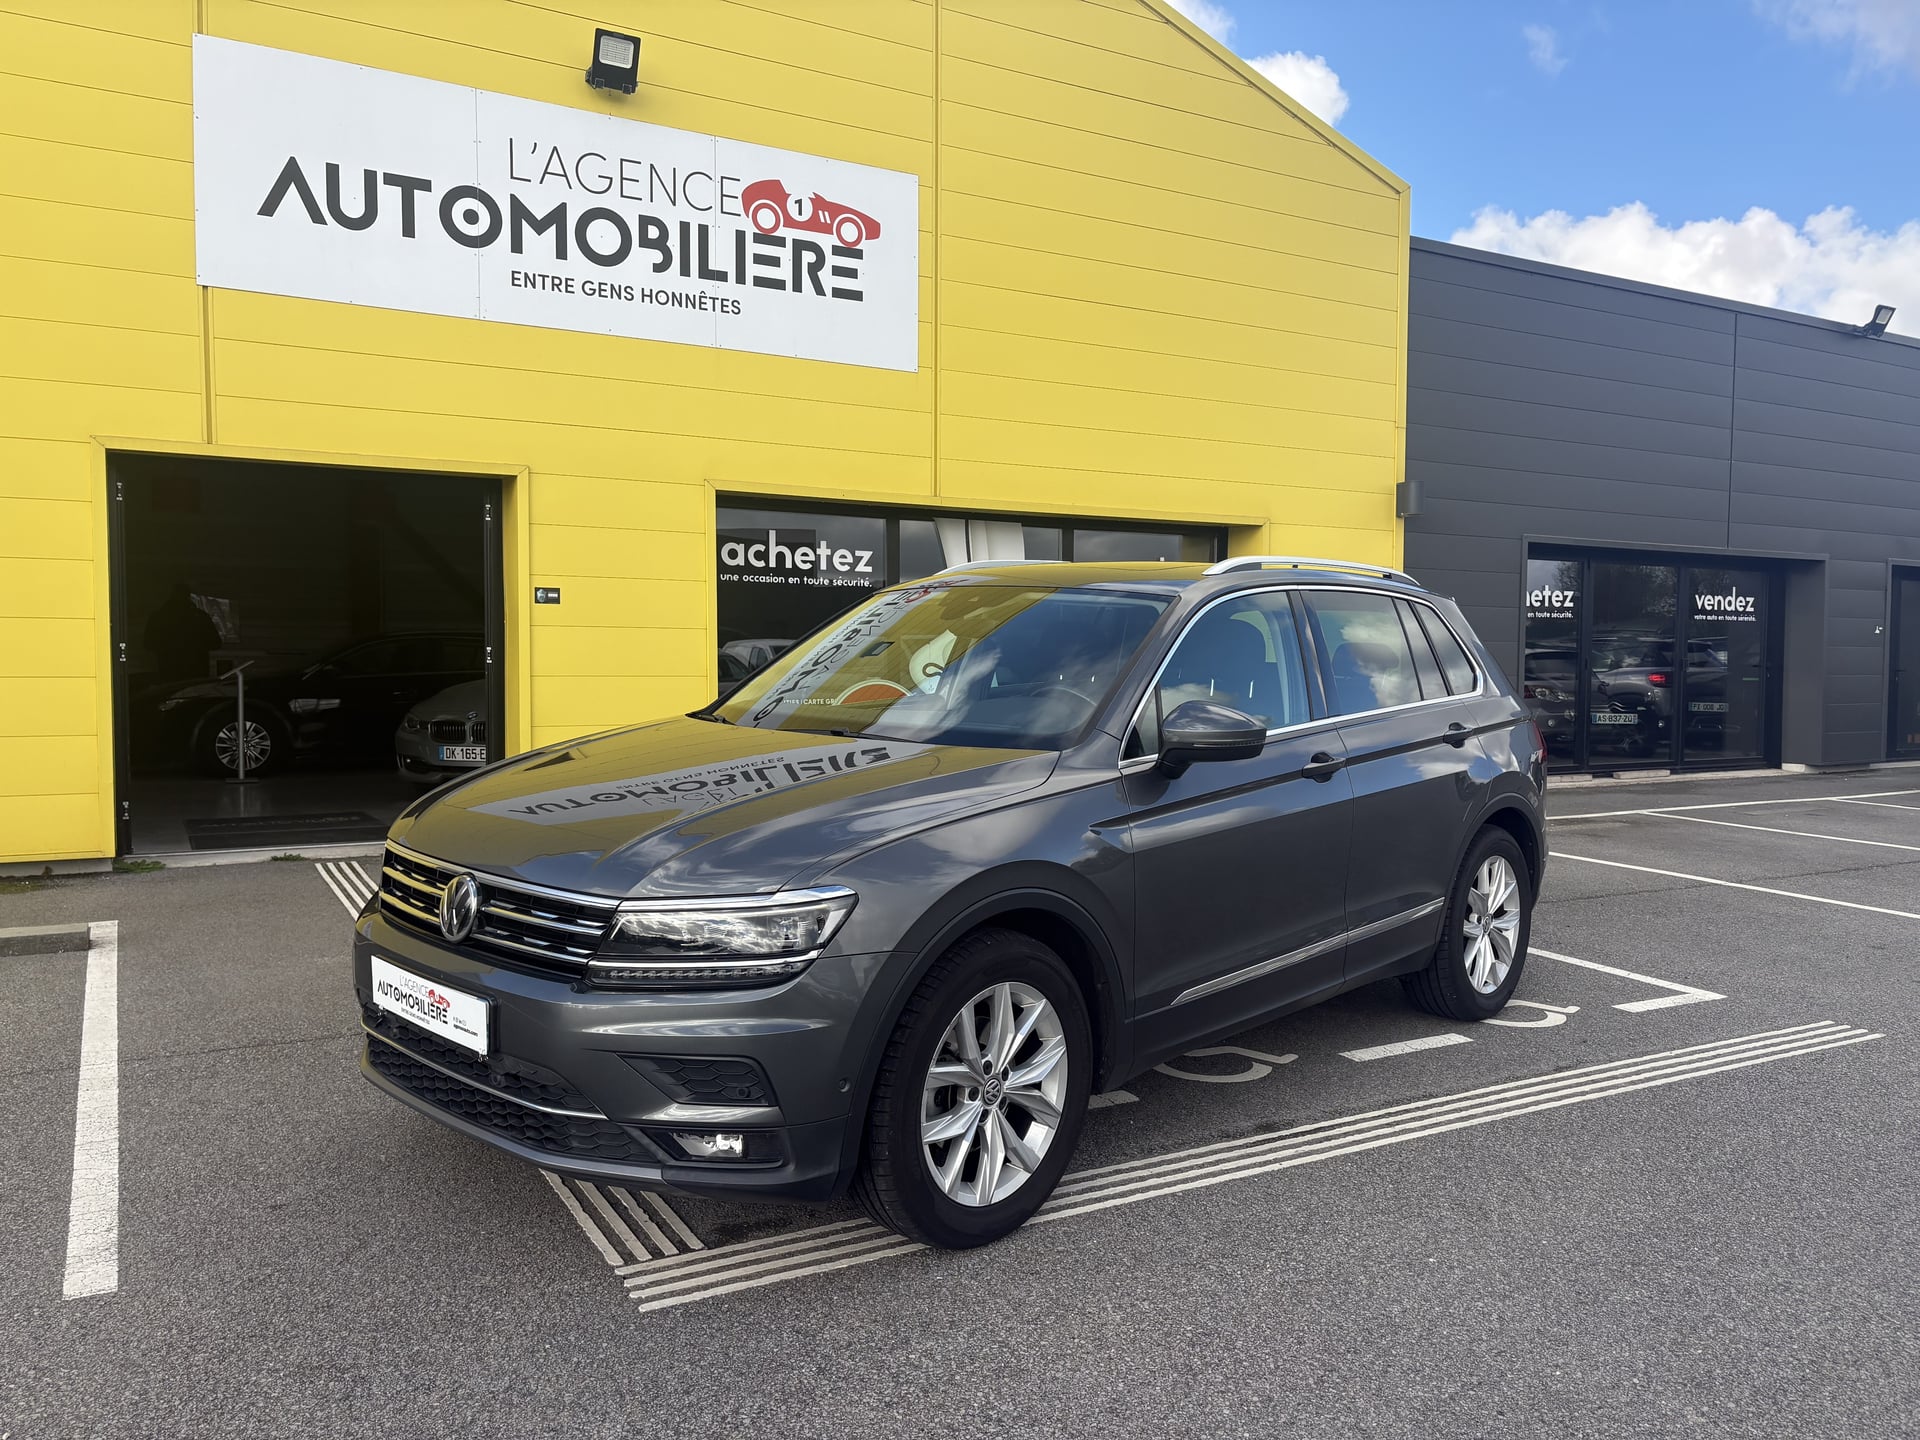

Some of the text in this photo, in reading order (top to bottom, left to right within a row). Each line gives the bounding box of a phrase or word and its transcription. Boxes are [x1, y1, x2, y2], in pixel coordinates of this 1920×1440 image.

[510, 137, 742, 217] L'AGENCE
[257, 156, 863, 302] AUTOMOBILIERE
[512, 270, 742, 316] ENTRE GENS HONNÊTES
[720, 529, 873, 573] achetez
[720, 572, 873, 588] une occasion en toute sécurité.
[1694, 586, 1755, 612] vendez
[445, 747, 486, 760] DK-165-E
[400, 974, 430, 998] L'AGENCE
